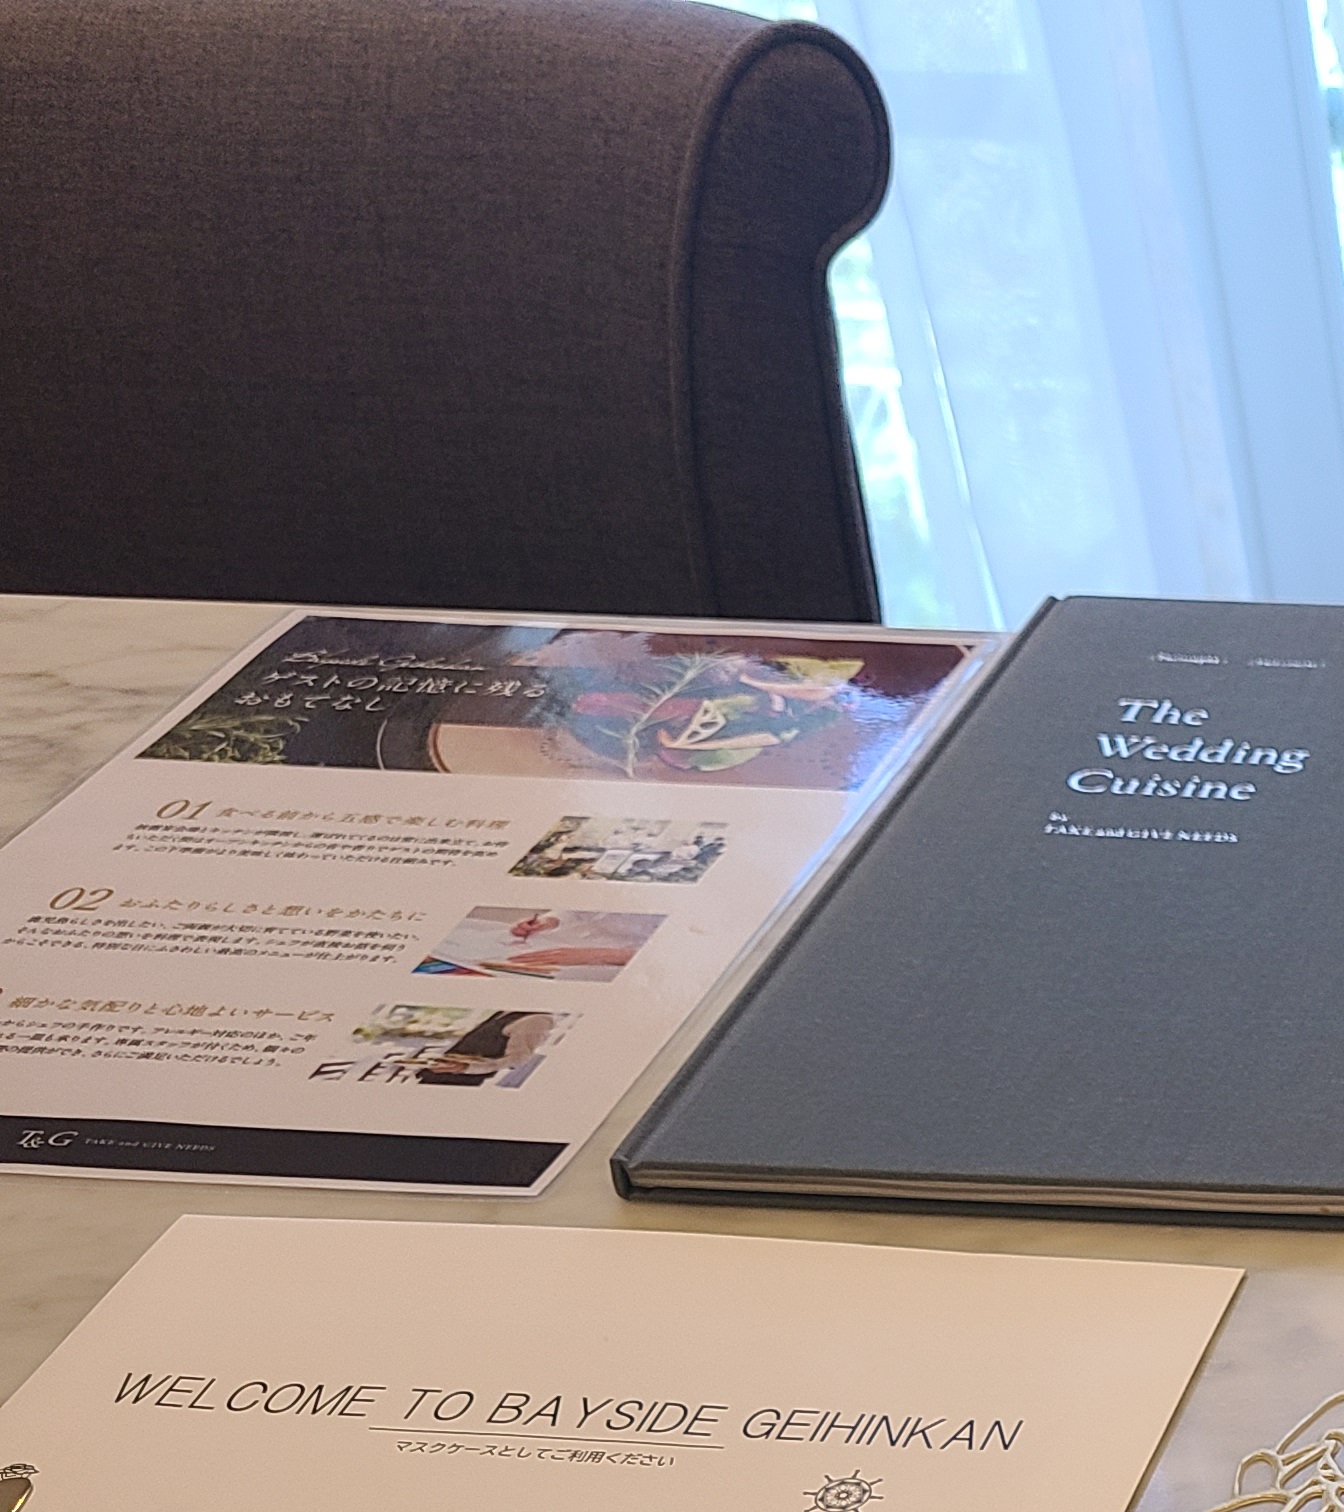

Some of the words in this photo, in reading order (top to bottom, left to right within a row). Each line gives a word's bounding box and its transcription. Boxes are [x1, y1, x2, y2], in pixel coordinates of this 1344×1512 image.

[261, 671, 547, 698] ゲストの記憶に残る
[233, 692, 386, 712] おもてなし
[1117, 697, 1209, 727] The
[1097, 733, 1310, 773] Wedding
[1066, 768, 1257, 800] Cuisine
[156, 799, 214, 821] 01
[48, 887, 114, 911] 02
[118, 898, 427, 922] おふたりらしさと想いをかたちに
[8, 996, 335, 1023] 細かな気配りと心地よいサービス
[17, 1129, 79, 1149] T&G
[113, 1372, 387, 1418] WELCOME
[403, 1387, 475, 1421] TO
[485, 1391, 728, 1438] BAYSIDE
[741, 1408, 1024, 1452] GEIHINKAN
[395, 1440, 676, 1468] マスクケースとしてご利用ください
